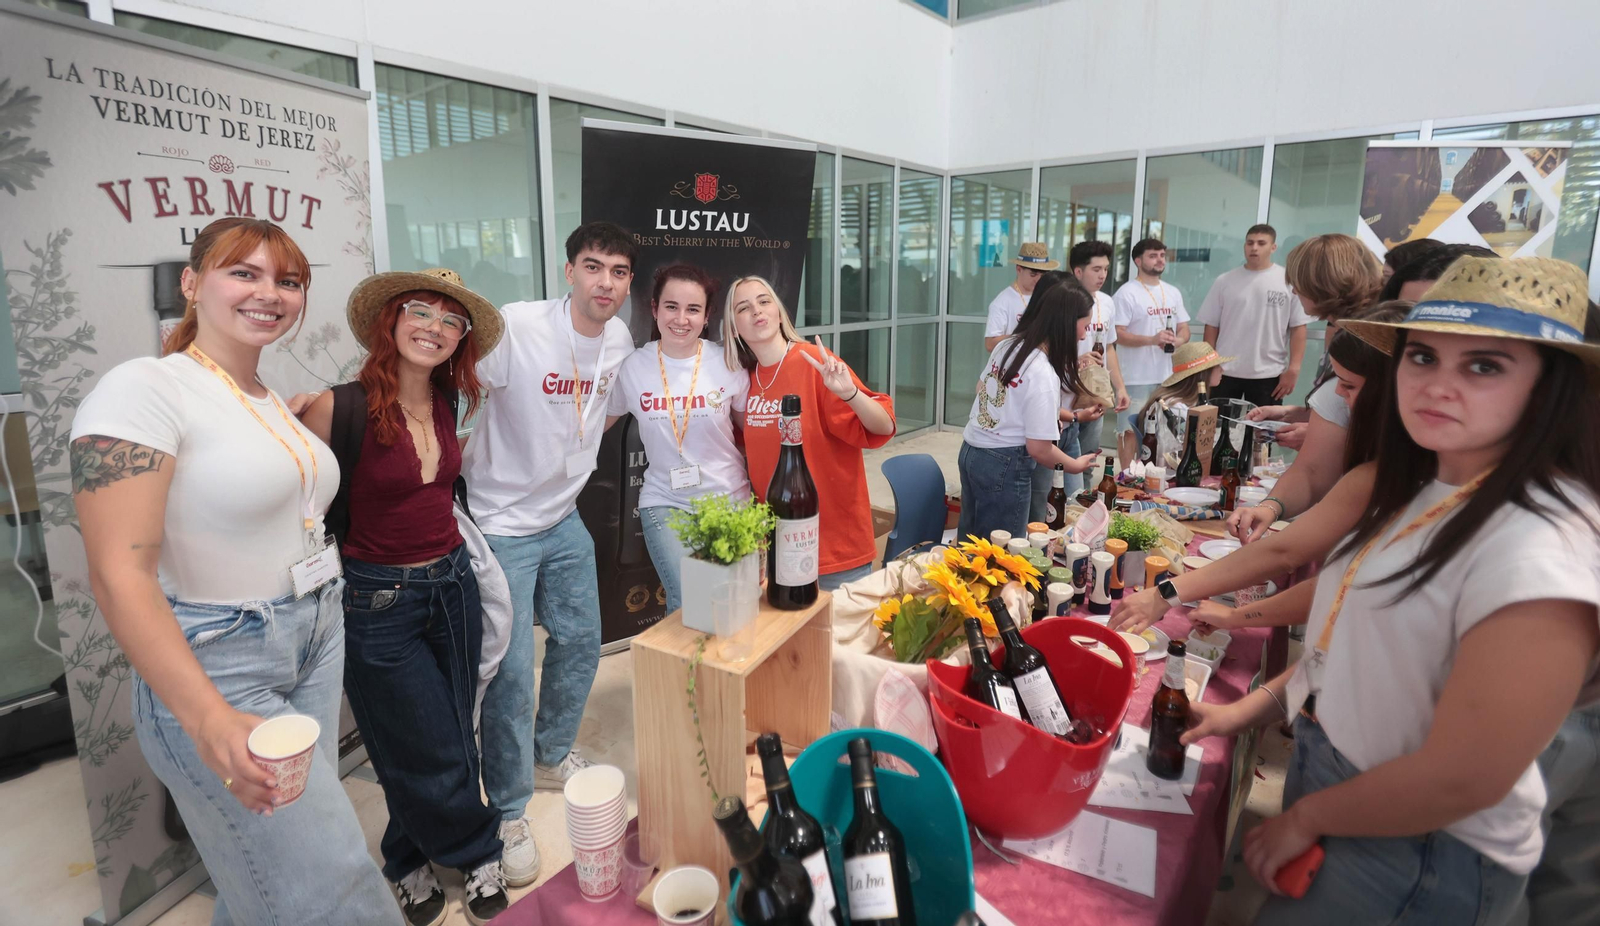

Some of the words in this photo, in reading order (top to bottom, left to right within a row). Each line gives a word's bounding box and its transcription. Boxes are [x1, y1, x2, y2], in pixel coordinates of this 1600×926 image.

[45, 57, 84, 85] LA
[93, 67, 232, 113] TRADICIÓN
[240, 98, 276, 121] DEL
[283, 106, 338, 132] MEJOR
[90, 95, 211, 137] VERMUT
[220, 118, 250, 141] DE
[257, 125, 316, 152] JEREZ
[161, 146, 189, 157] ROJO
[254, 158, 271, 168] RED
[97, 176, 322, 230] VERMUT
[655, 208, 750, 232] LUSTAU
